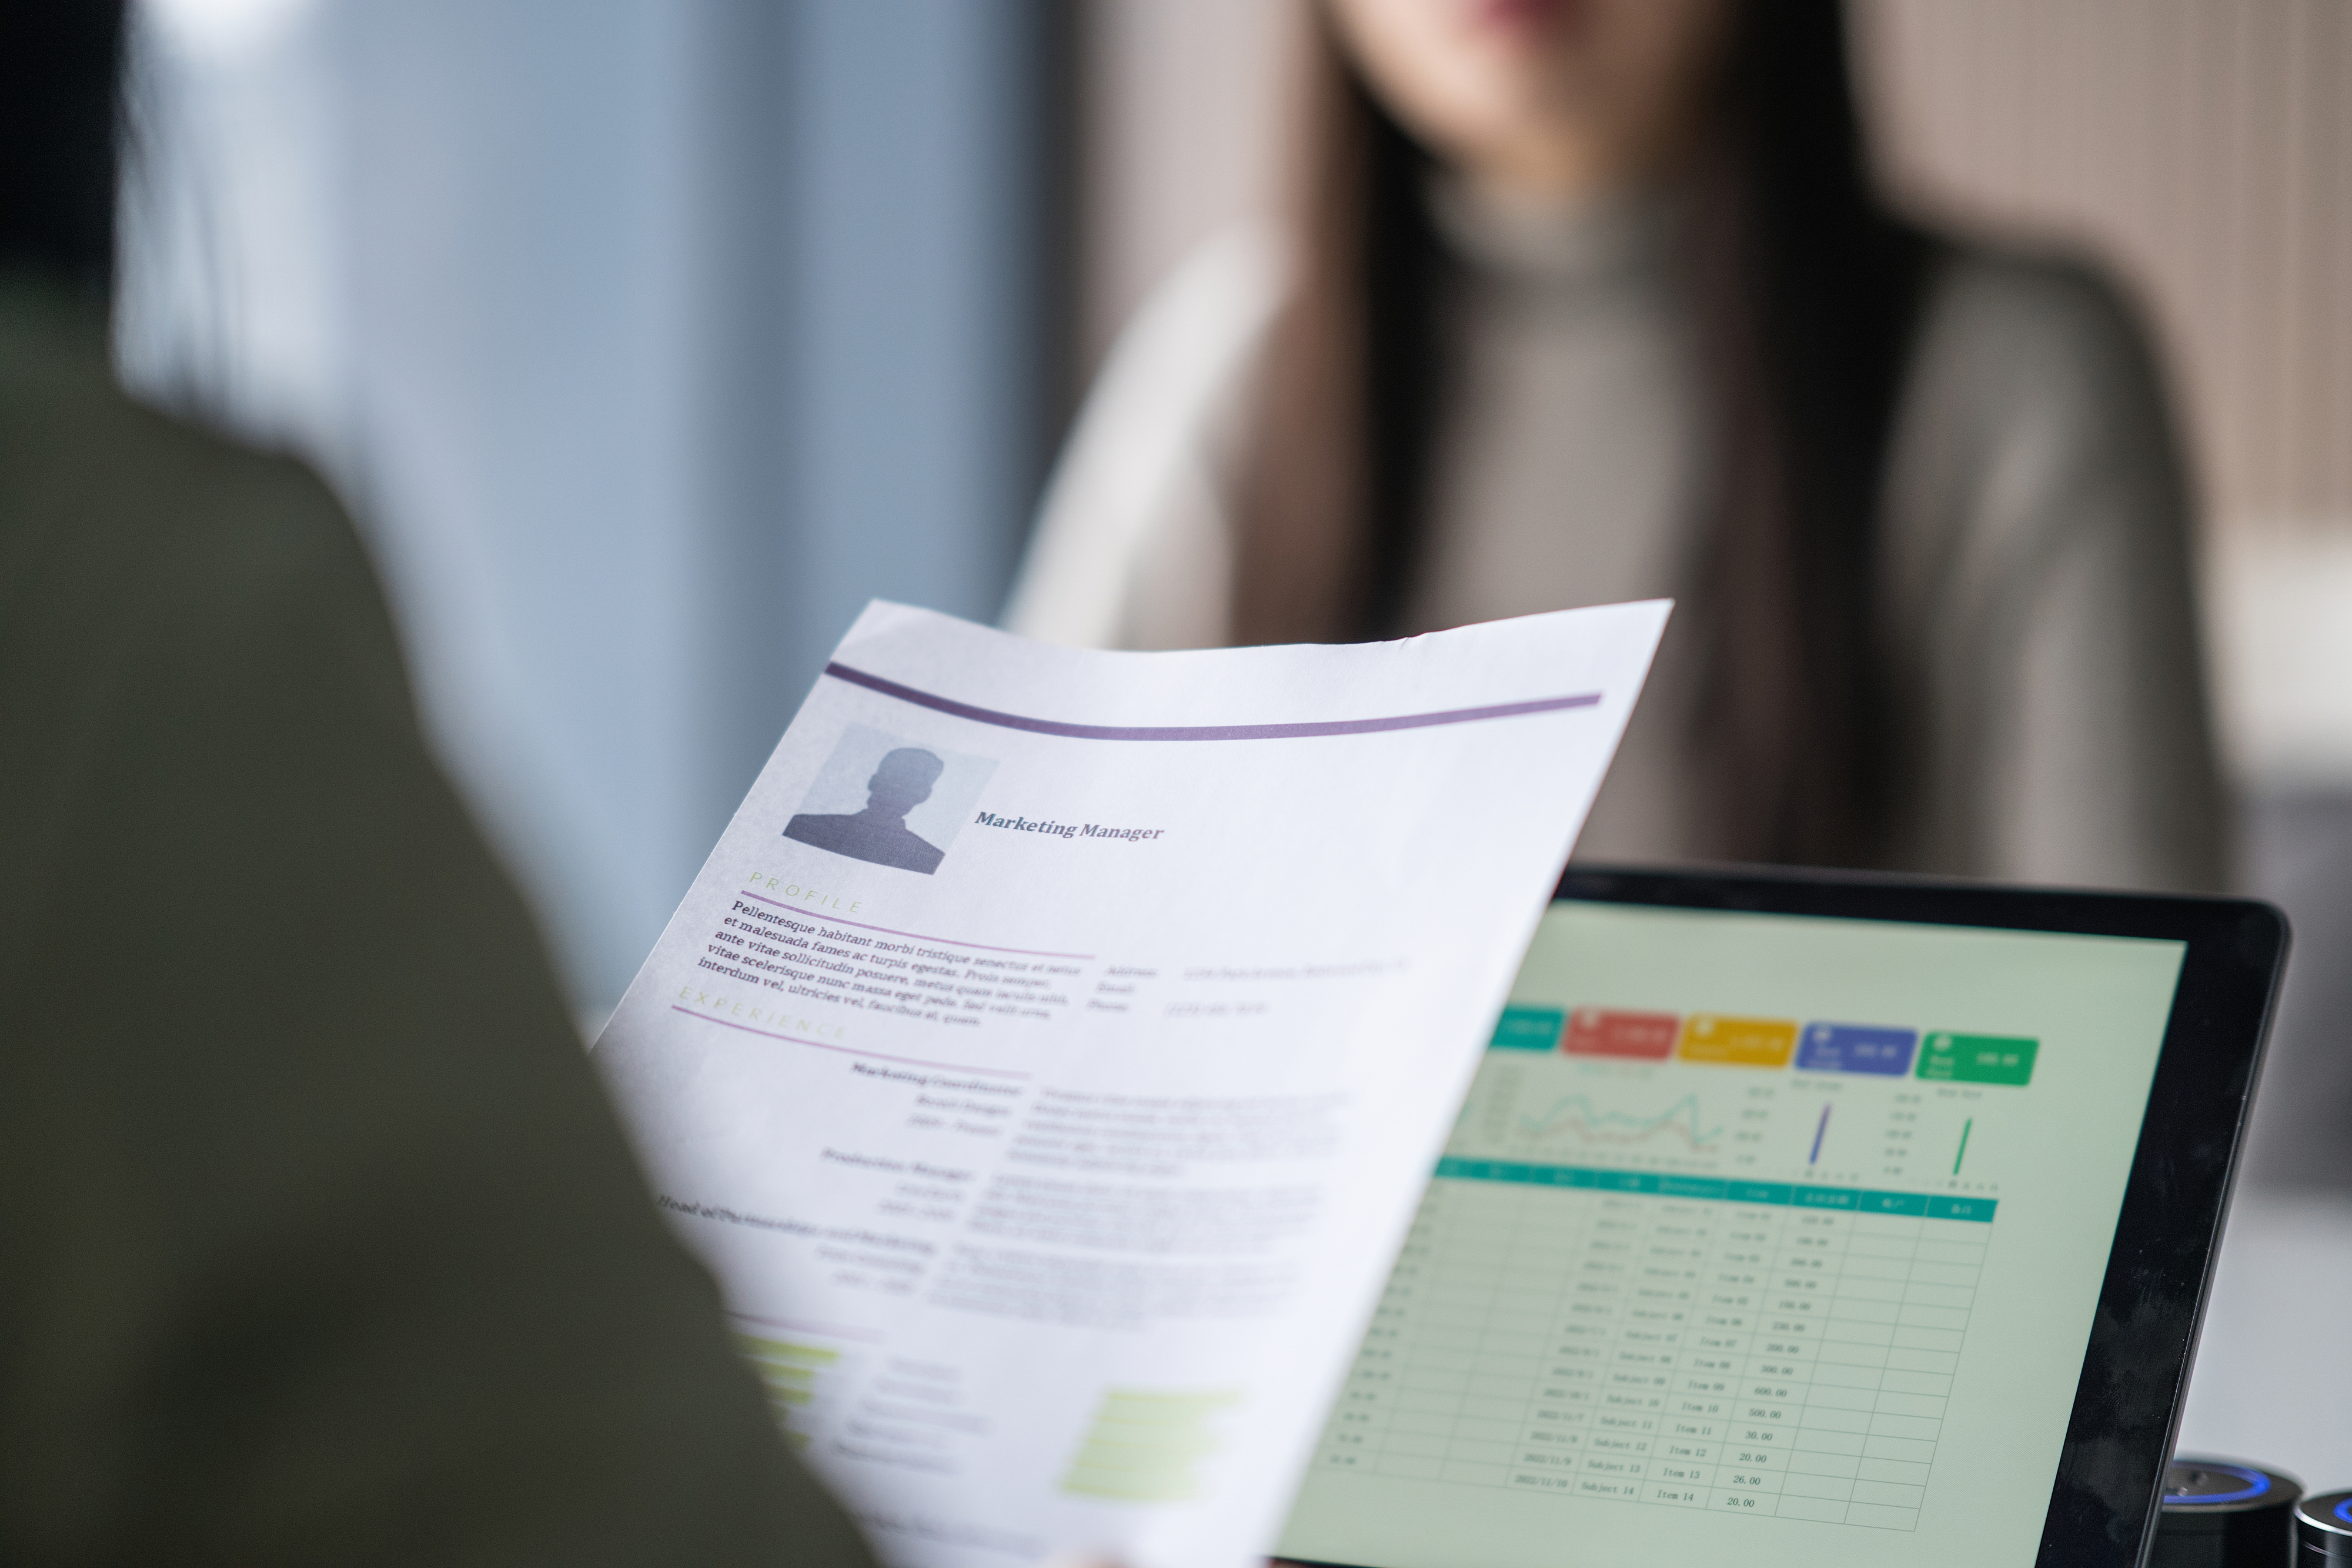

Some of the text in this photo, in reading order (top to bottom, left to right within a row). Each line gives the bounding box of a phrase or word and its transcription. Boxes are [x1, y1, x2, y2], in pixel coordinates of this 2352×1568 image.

[974, 811, 1165, 842] Marketing Manager
[749, 871, 864, 914] PROFILE
[724, 917, 739, 927] et
[739, 921, 809, 949] malesuada
[810, 941, 851, 958] fames
[851, 951, 868, 961] ac
[870, 954, 909, 969] turpis
[911, 962, 960, 977] egestas.
[731, 900, 816, 934] Pellentesque
[817, 927, 873, 947] habitant
[874, 940, 916, 955] morbi
[916, 947, 971, 964] tristique
[707, 944, 740, 961] vitae
[741, 955, 815, 981] scelerisque
[817, 974, 850, 989] nunc
[851, 982, 892, 997] massa
[715, 930, 744, 946] ante
[748, 941, 780, 957] vitae
[781, 951, 854, 974] sollicitudin
[854, 967, 909, 985] posuere,
[914, 978, 954, 992] metus
[697, 957, 760, 984] interdum
[763, 978, 785, 992] vel,
[787, 984, 841, 1004] ultricies
[843, 996, 864, 1008] vel,
[679, 986, 848, 1039] EXPERIENCE
[1681, 1401, 1704, 1412] Item
[1748, 1407, 1782, 1420] 500.00
[1753, 1386, 1788, 1399] 600.00
[1641, 1420, 1653, 1430] 11
[1675, 1423, 1698, 1435] Item
[1701, 1426, 1712, 1436] 11
[1744, 1429, 1773, 1442] 30.00
[1594, 1437, 1631, 1450] Subject
[1635, 1442, 1648, 1452] 12
[1669, 1445, 1692, 1457] Item
[1695, 1447, 1708, 1457] 12
[1739, 1452, 1768, 1465] 20.00
[1587, 1459, 1625, 1472] Subject
[1629, 1464, 1641, 1474] 13
[1663, 1467, 1685, 1479] Item
[1689, 1470, 1701, 1480] 13
[1732, 1474, 1762, 1486] 26.00
[1580, 1480, 1618, 1495] Subject
[1622, 1486, 1635, 1496] 14
[1657, 1489, 1679, 1501] Item
[1683, 1492, 1695, 1502] 14
[1726, 1496, 1756, 1509] 20.00
